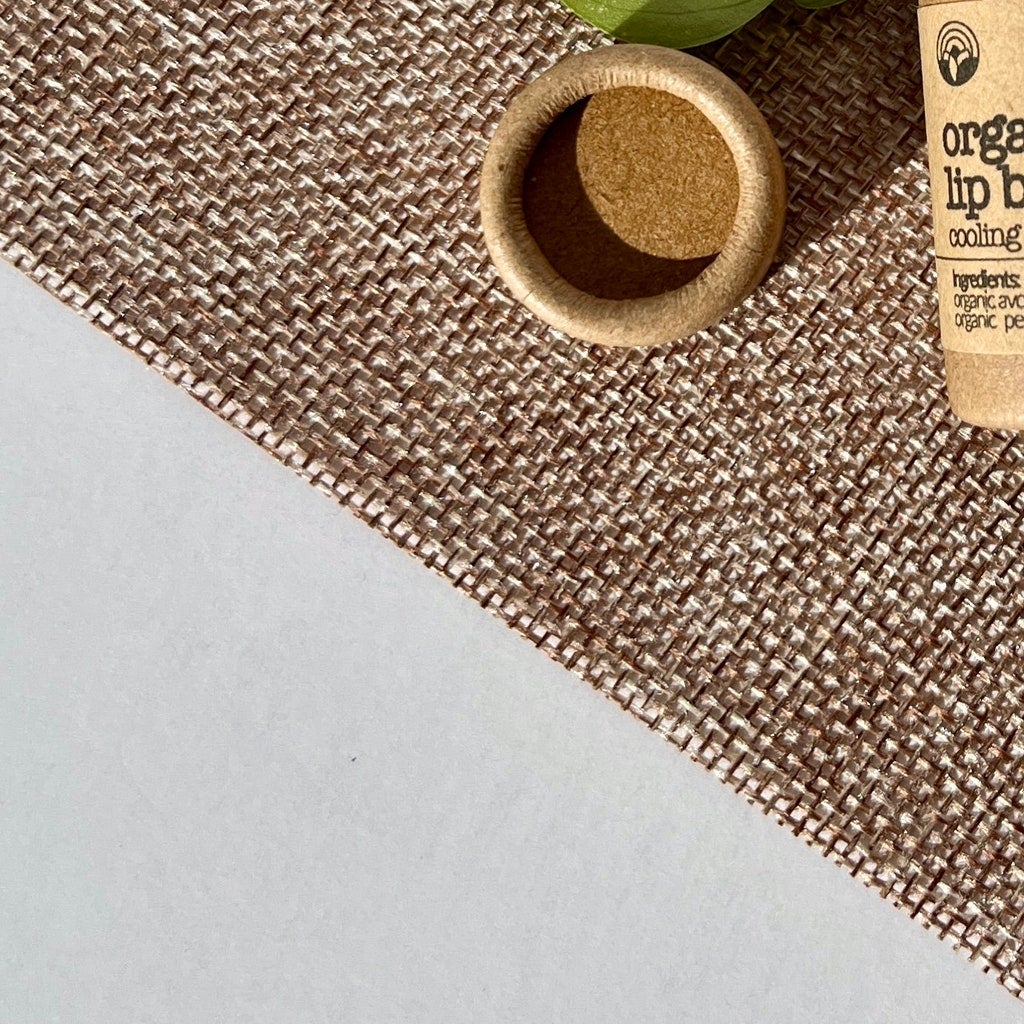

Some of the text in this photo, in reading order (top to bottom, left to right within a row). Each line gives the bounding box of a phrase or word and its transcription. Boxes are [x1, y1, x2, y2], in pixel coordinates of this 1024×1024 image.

[943, 166, 991, 220] lip
[949, 222, 1023, 252] cooling
[953, 289, 996, 313] organic
[955, 308, 998, 333] organic
